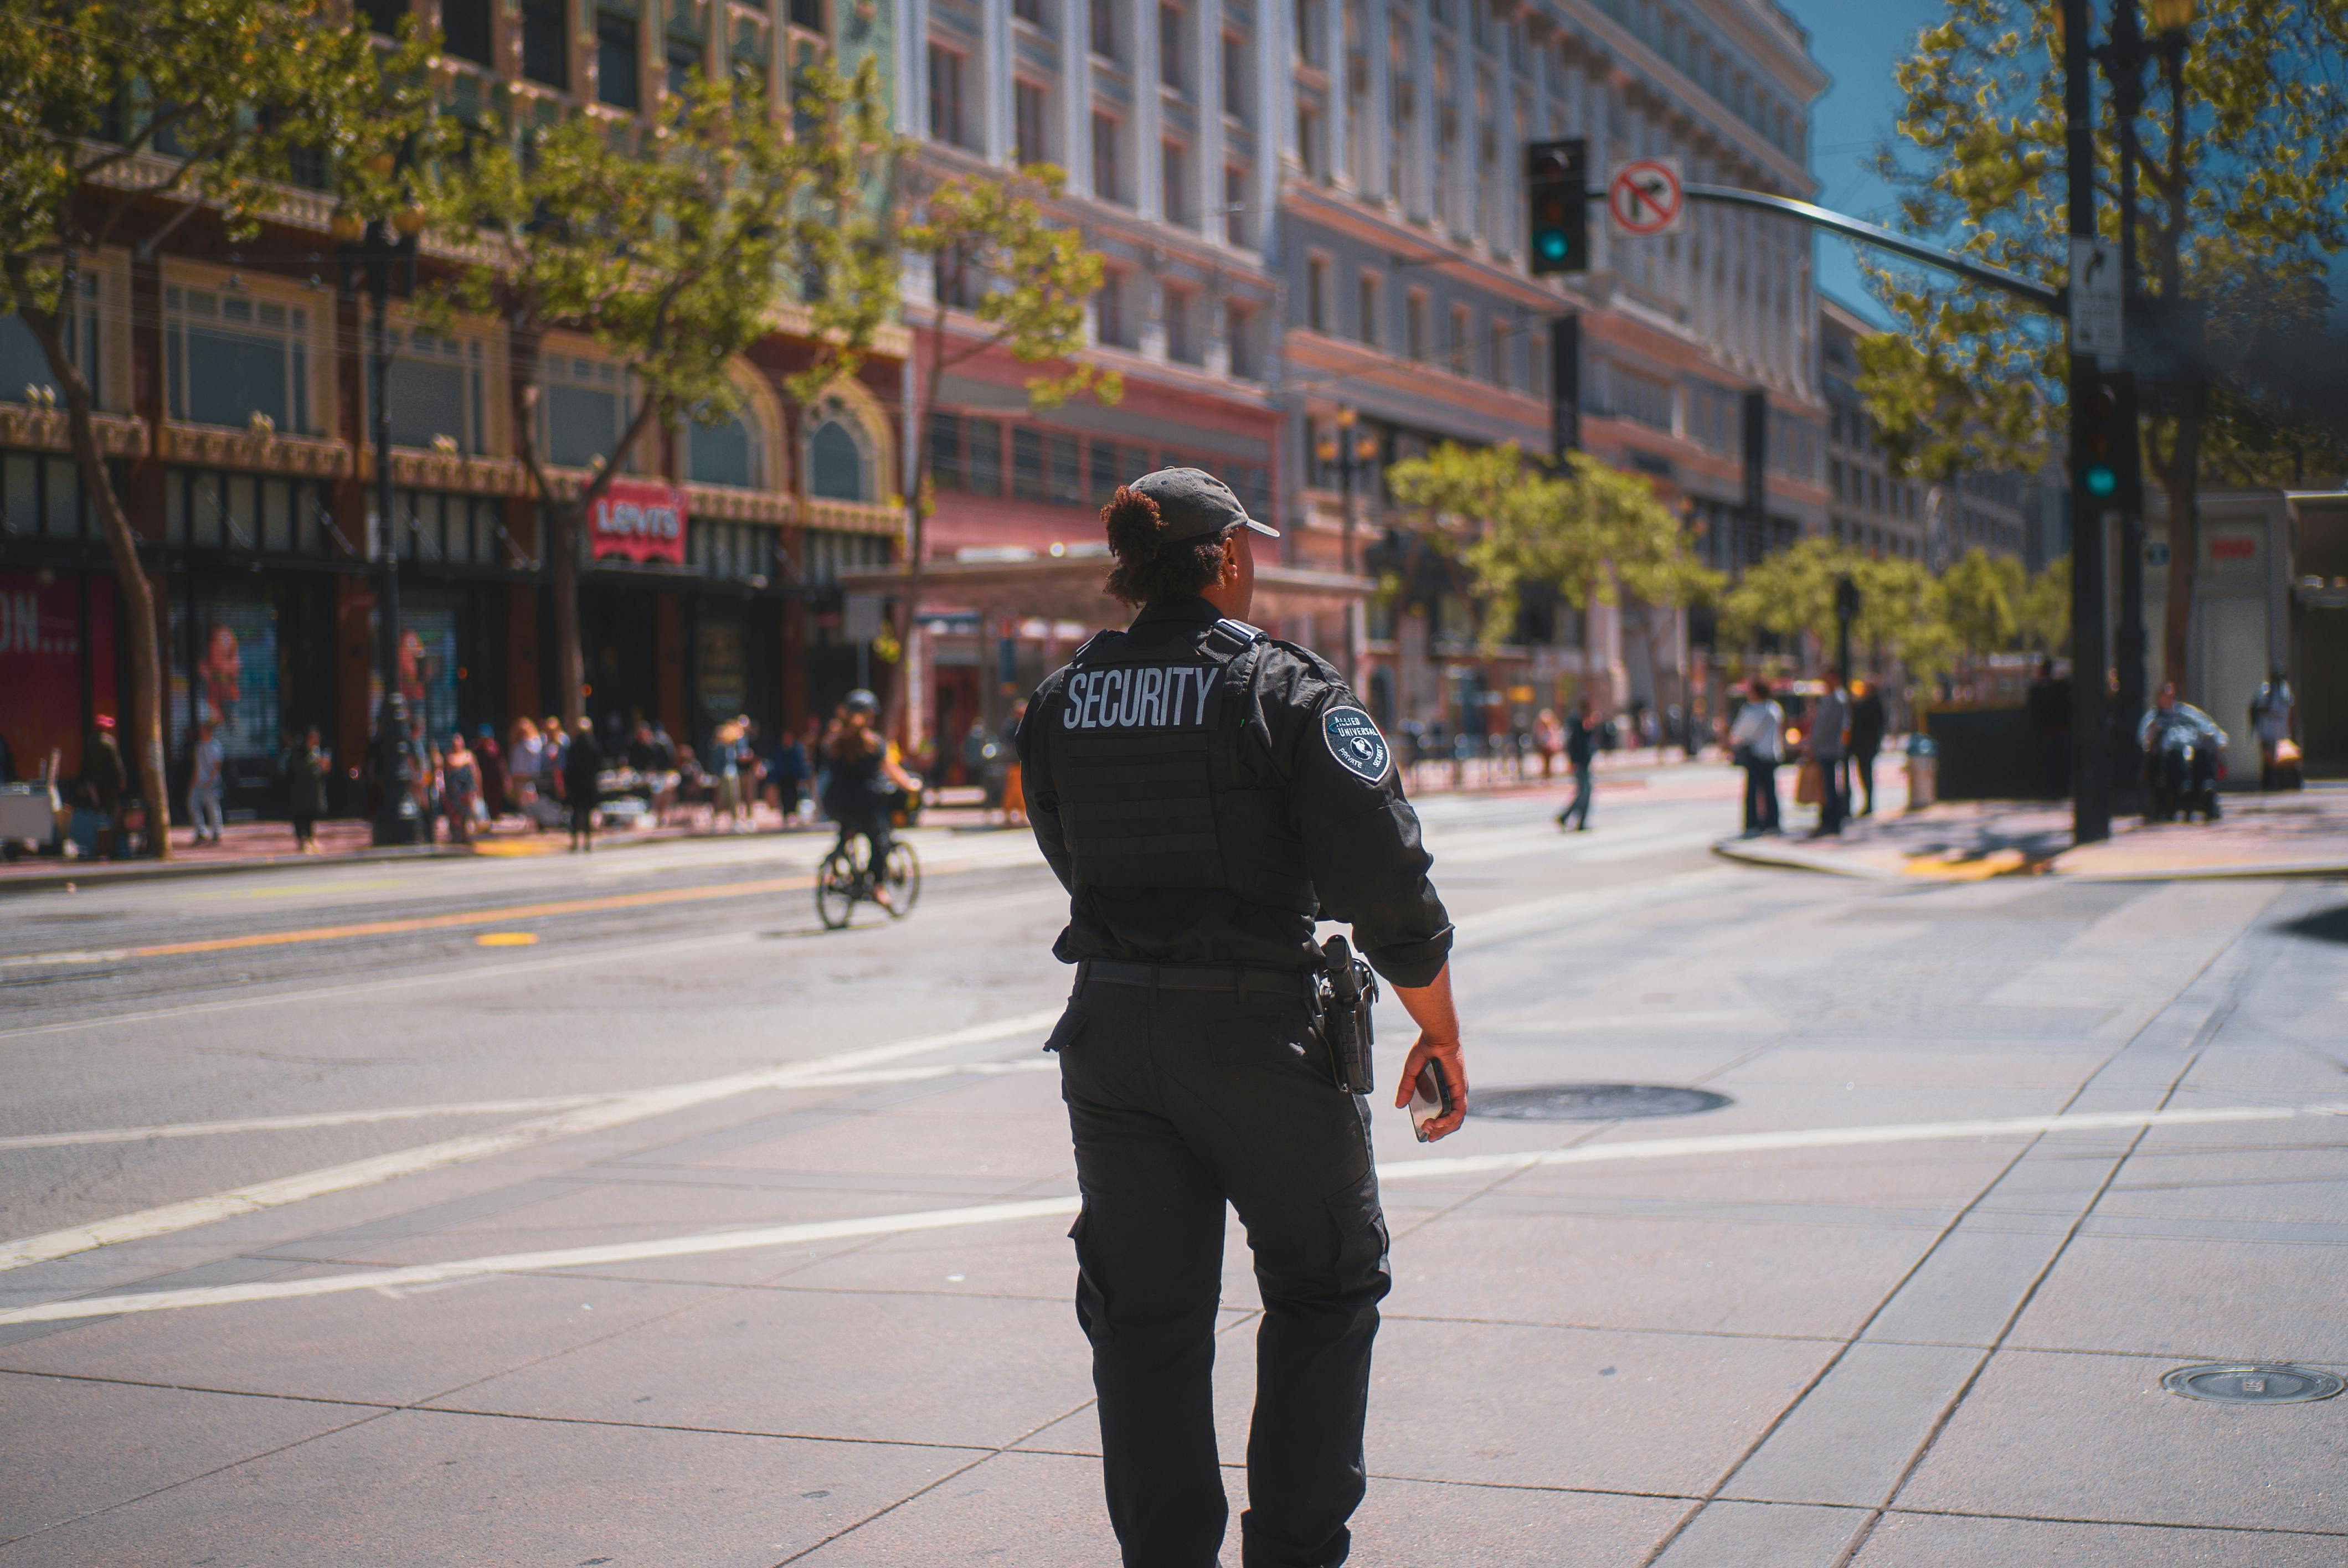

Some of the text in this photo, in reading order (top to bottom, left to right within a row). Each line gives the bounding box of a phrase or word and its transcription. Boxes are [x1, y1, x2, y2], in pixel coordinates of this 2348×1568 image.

[1063, 667, 1219, 729] SECURITY
[1335, 716, 1361, 728] ALLIED
[1337, 727, 1378, 737] UNIVERSAL
[1338, 744, 1384, 768] PRIVATE SECURITY
